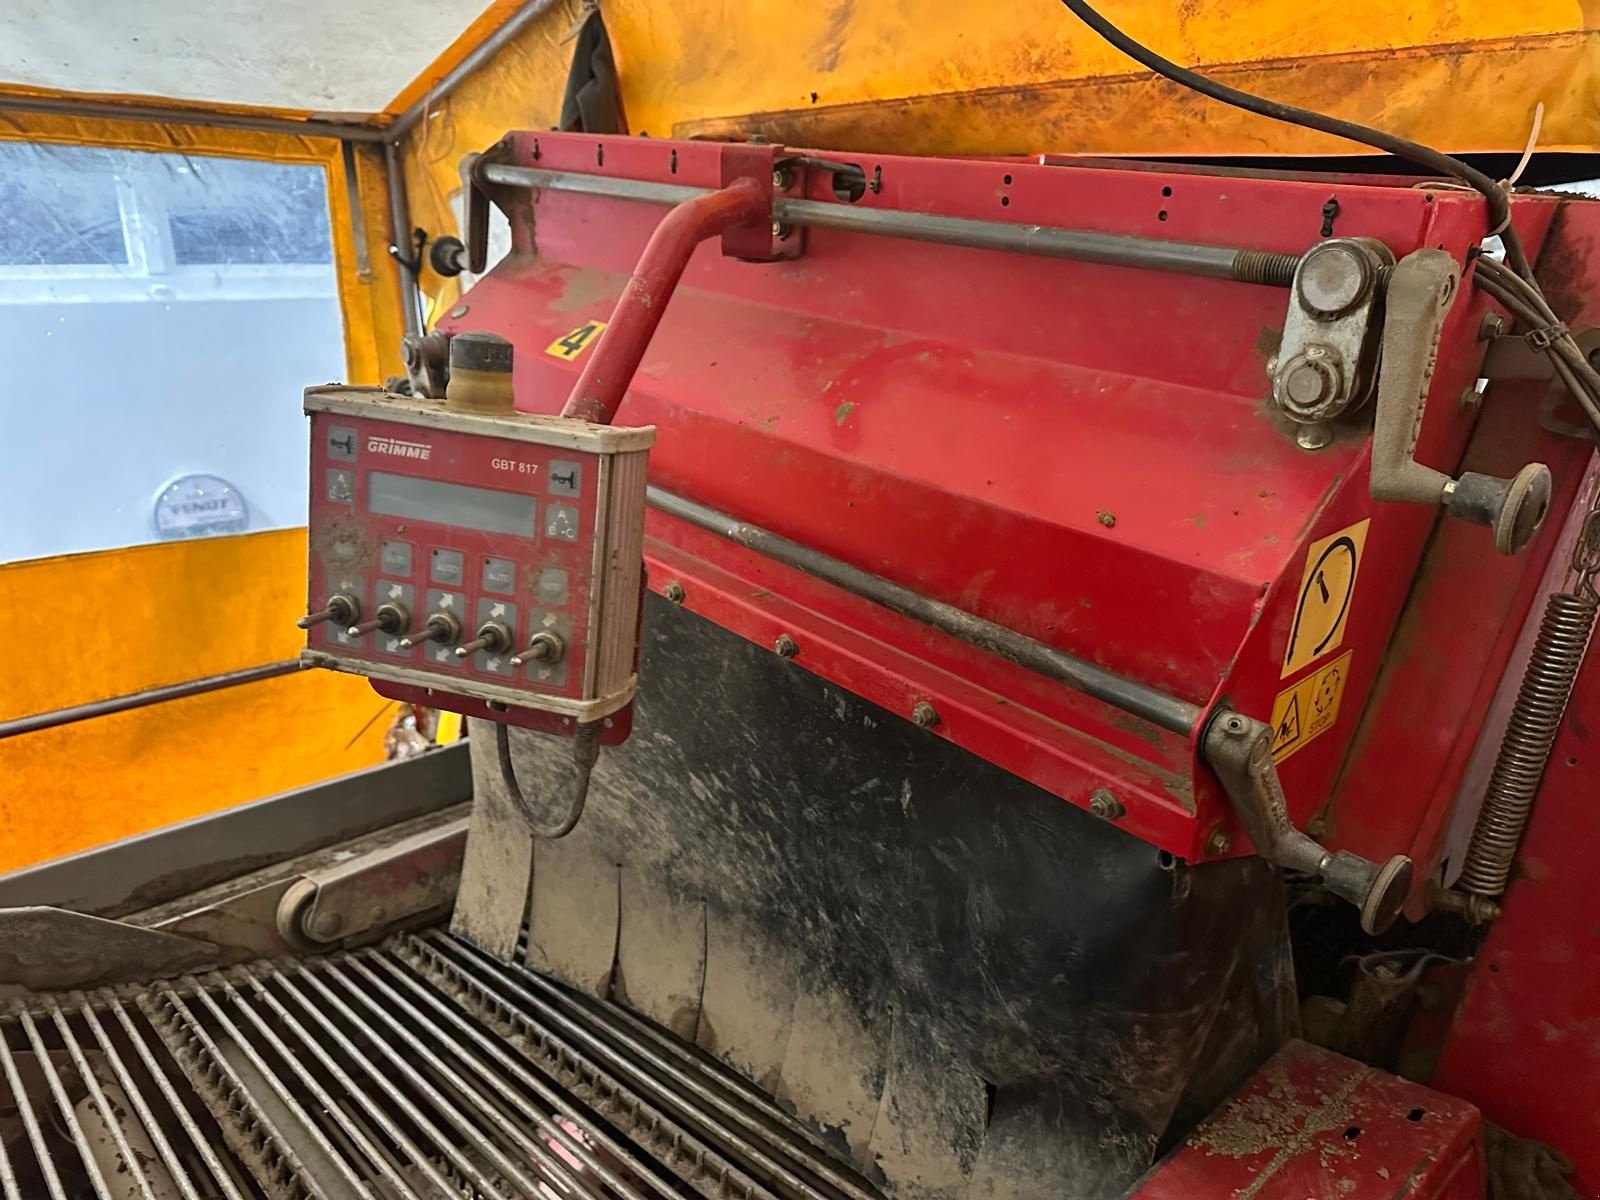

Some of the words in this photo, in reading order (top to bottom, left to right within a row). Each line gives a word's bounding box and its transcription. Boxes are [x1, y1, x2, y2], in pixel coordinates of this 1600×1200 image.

[559, 324, 597, 356] 4
[366, 437, 432, 461] GRIMME
[491, 458, 517, 472] GBT
[518, 463, 539, 475] 817
[557, 509, 567, 519] A
[1308, 711, 1331, 735] STOP
